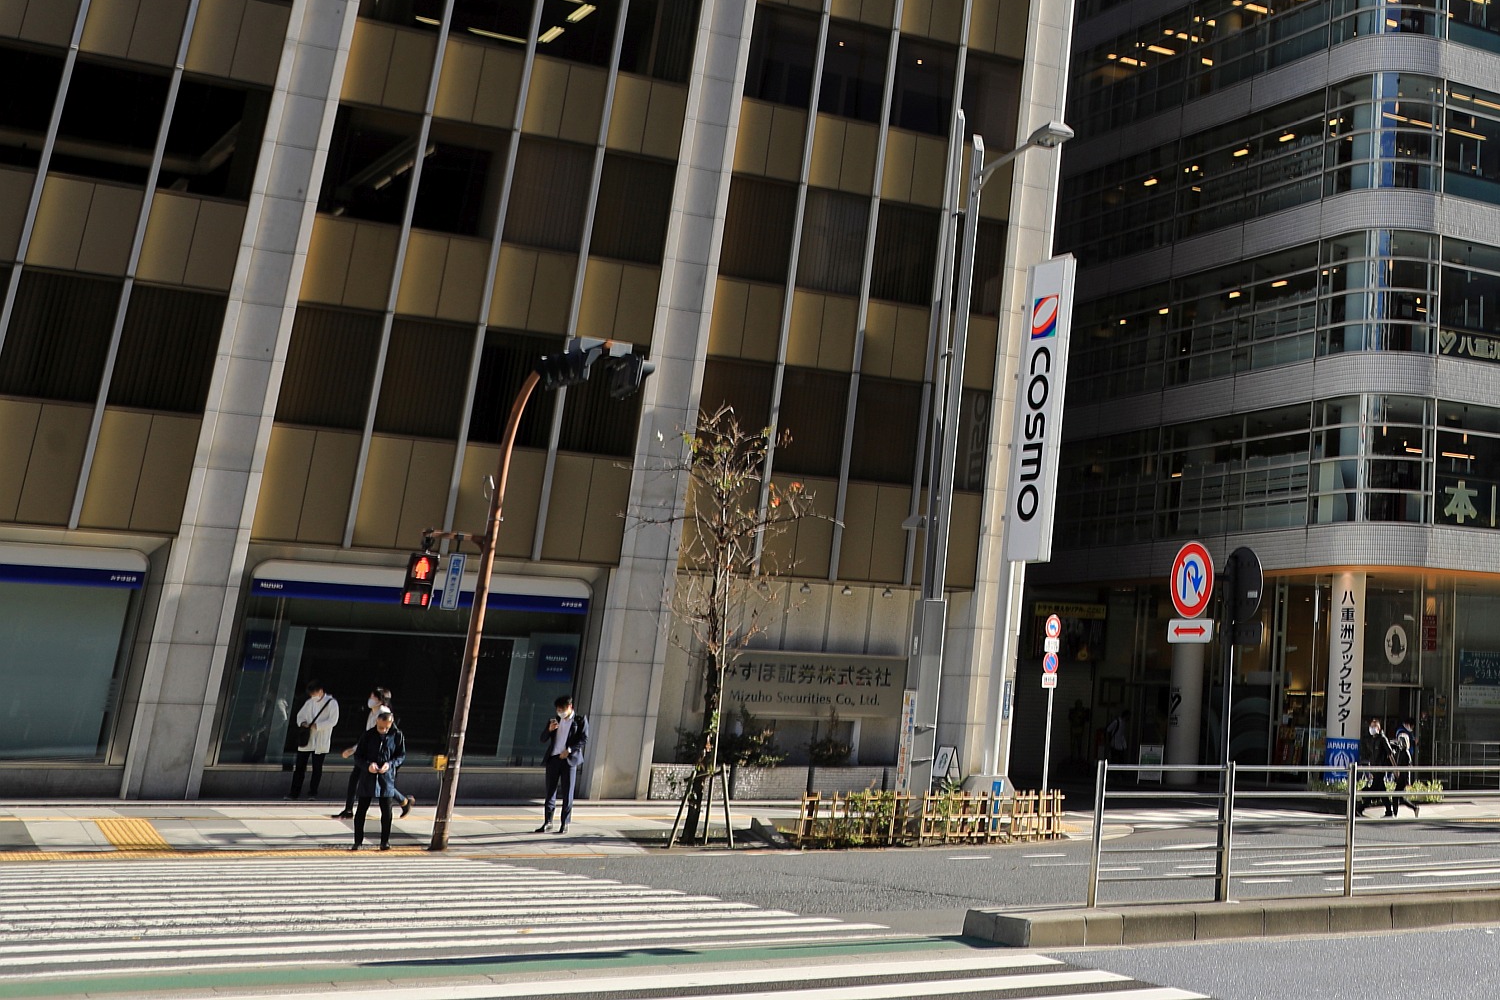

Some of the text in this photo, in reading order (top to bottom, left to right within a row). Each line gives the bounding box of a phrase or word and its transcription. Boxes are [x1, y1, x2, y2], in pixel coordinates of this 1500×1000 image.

[1444, 480, 1478, 524] 本
[723, 662, 892, 688] みずほ証券株式会社
[1338, 590, 1355, 737] 八重洲ブックセンター
[730, 690, 772, 704] Mizuho
[777, 692, 832, 704] Securities
[860, 694, 881, 706] Ltd.
[1327, 742, 1359, 750] JAPAN FOR
